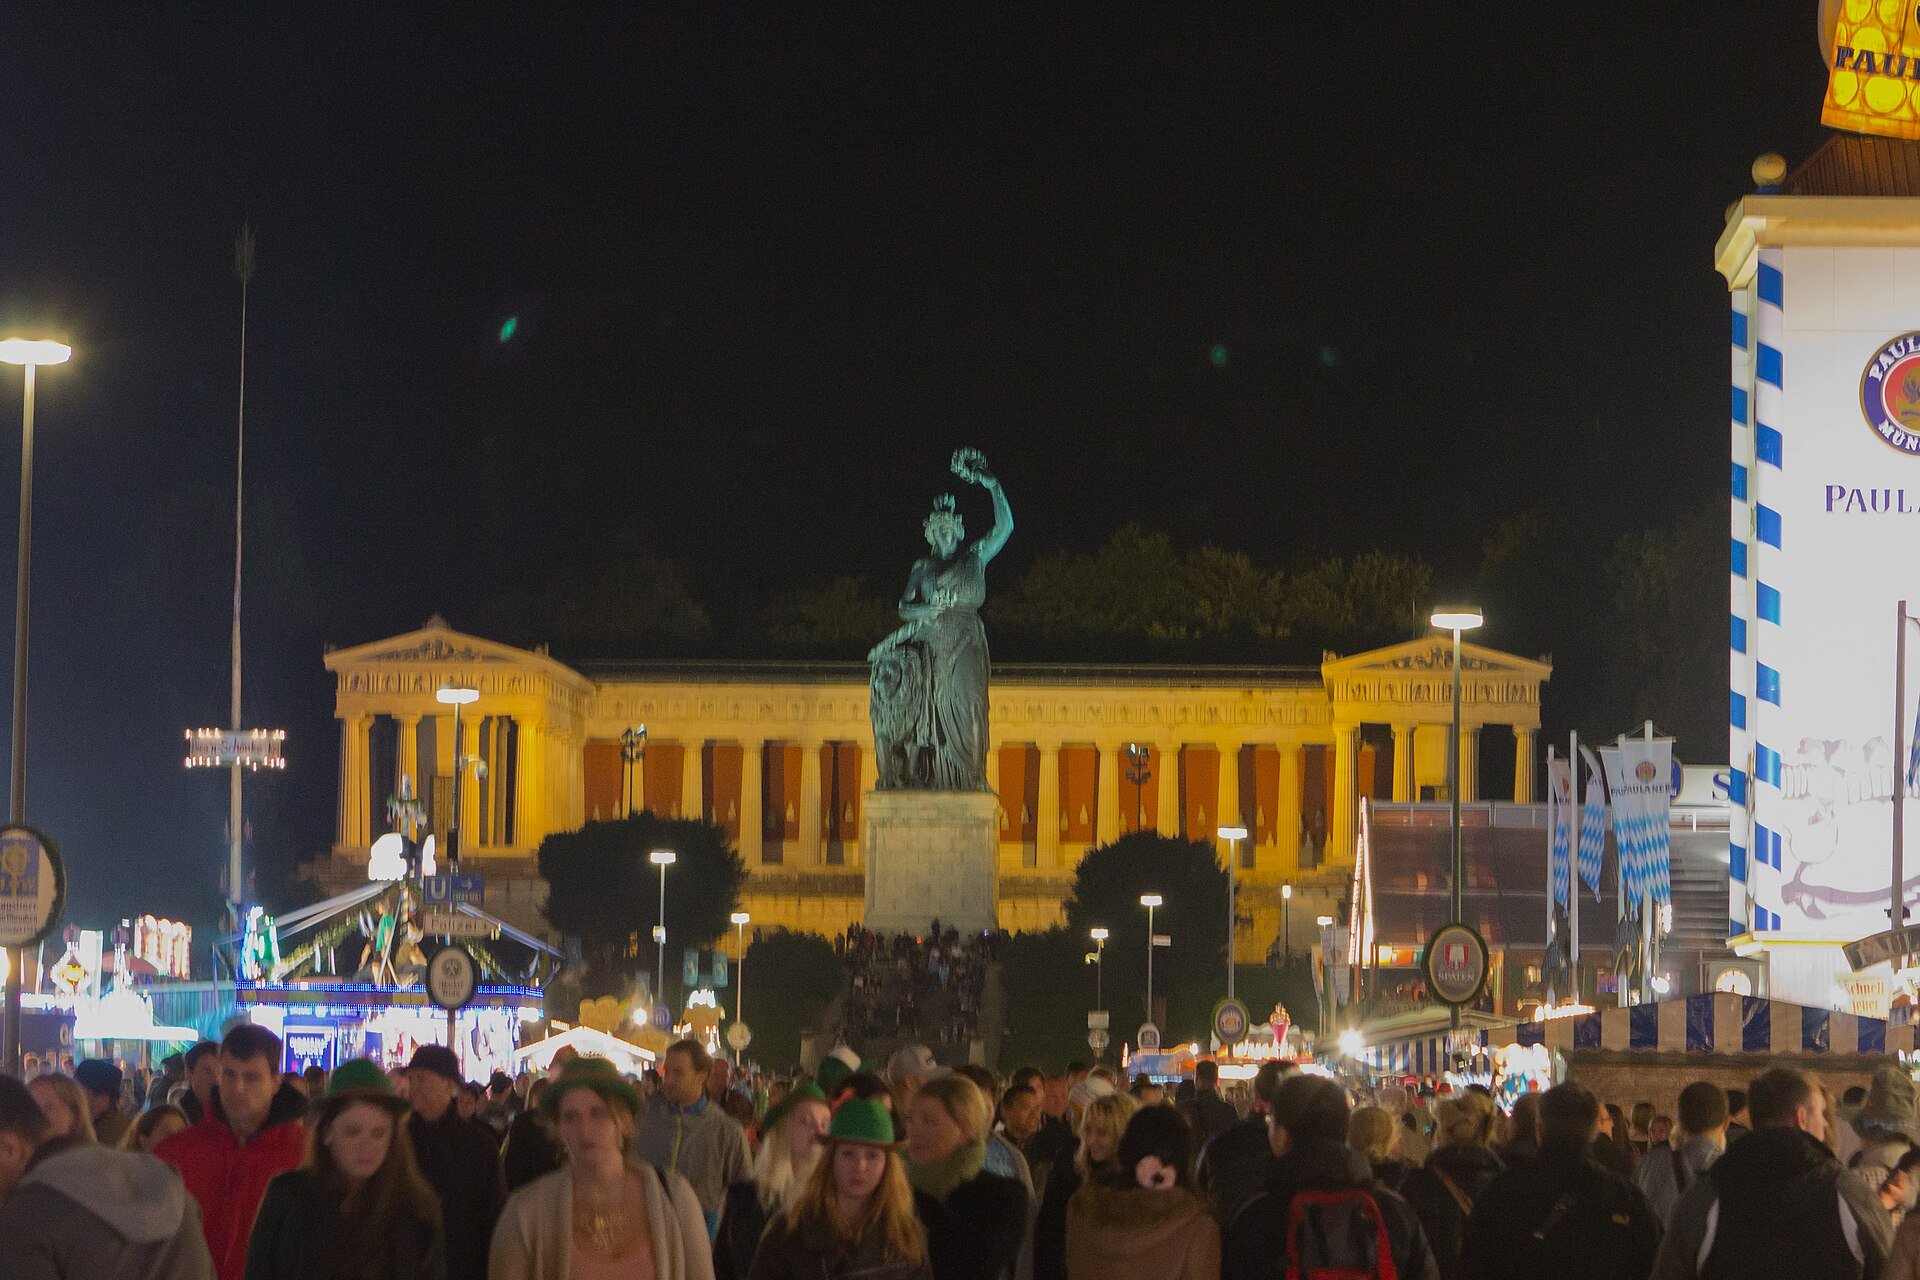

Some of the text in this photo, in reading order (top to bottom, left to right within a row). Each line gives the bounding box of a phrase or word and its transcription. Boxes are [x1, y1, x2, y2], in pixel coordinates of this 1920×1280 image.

[1825, 485, 1920, 513] PAUL
[1622, 784, 1672, 795] PAULANER
[431, 877, 446, 899] U
[432, 918, 477, 931] Polizei
[1438, 971, 1474, 981] SPATEN
